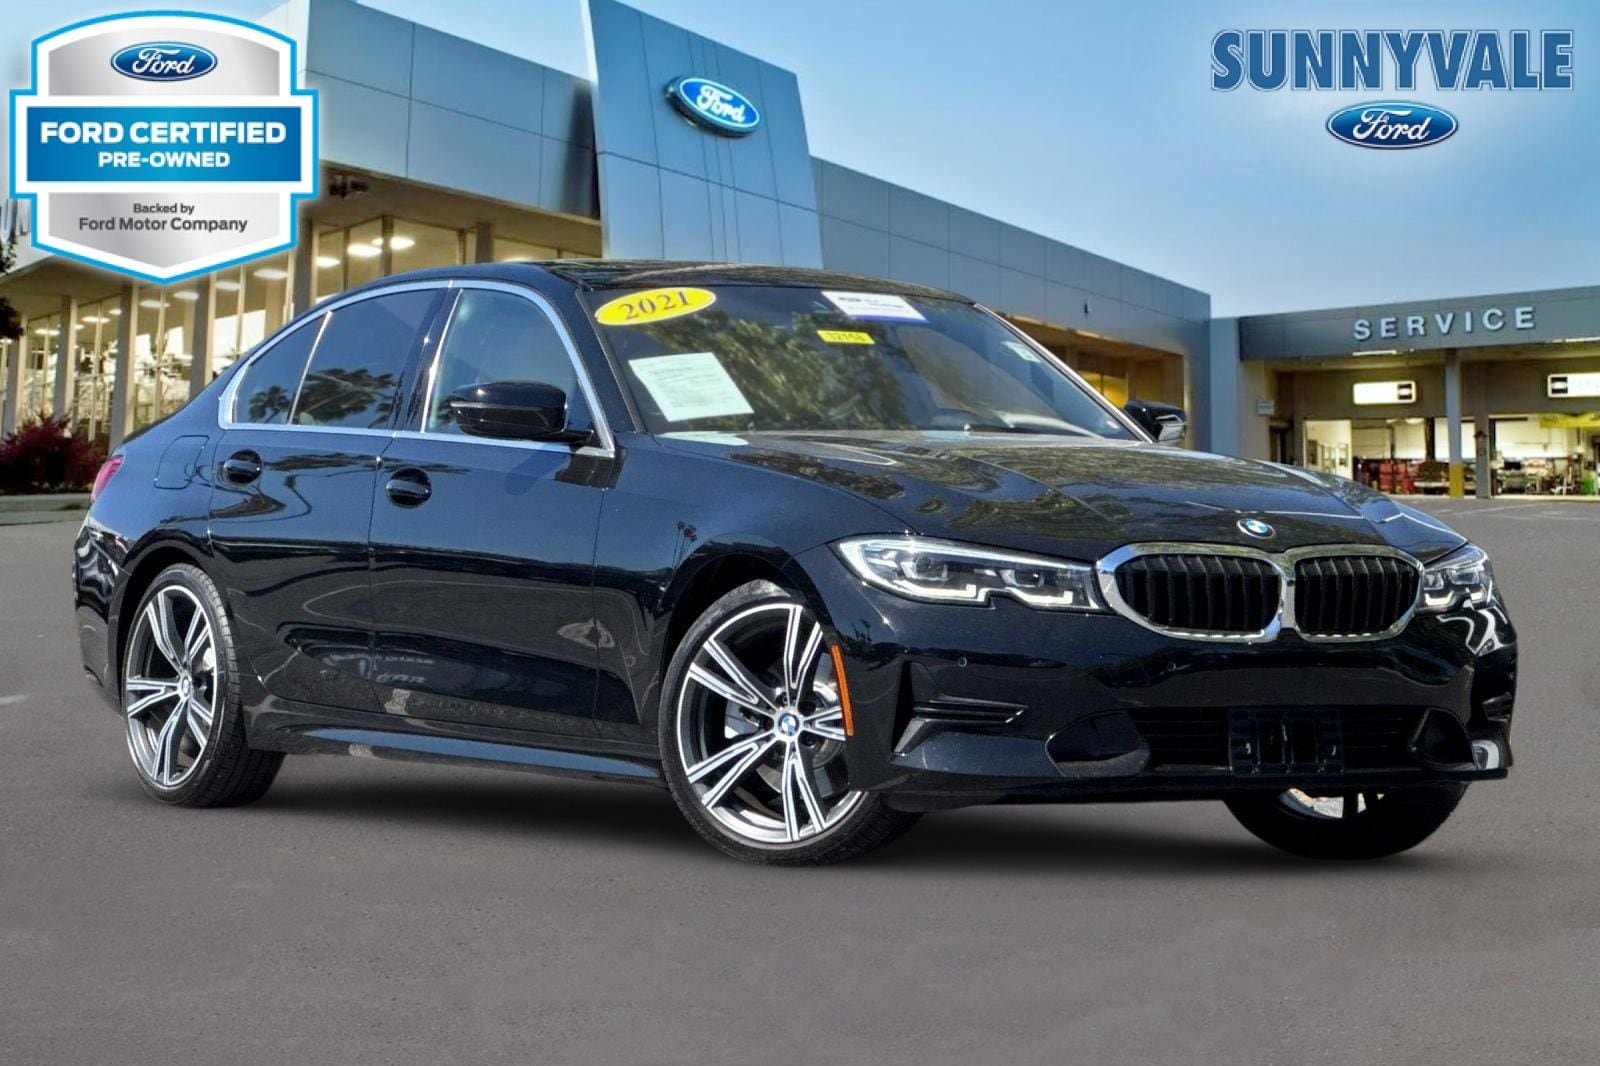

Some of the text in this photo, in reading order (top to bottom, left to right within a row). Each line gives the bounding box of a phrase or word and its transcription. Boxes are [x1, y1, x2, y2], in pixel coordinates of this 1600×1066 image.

[696, 85, 746, 122] Ford
[618, 290, 691, 321] 2021
[1352, 306, 1537, 341] SERVICE
